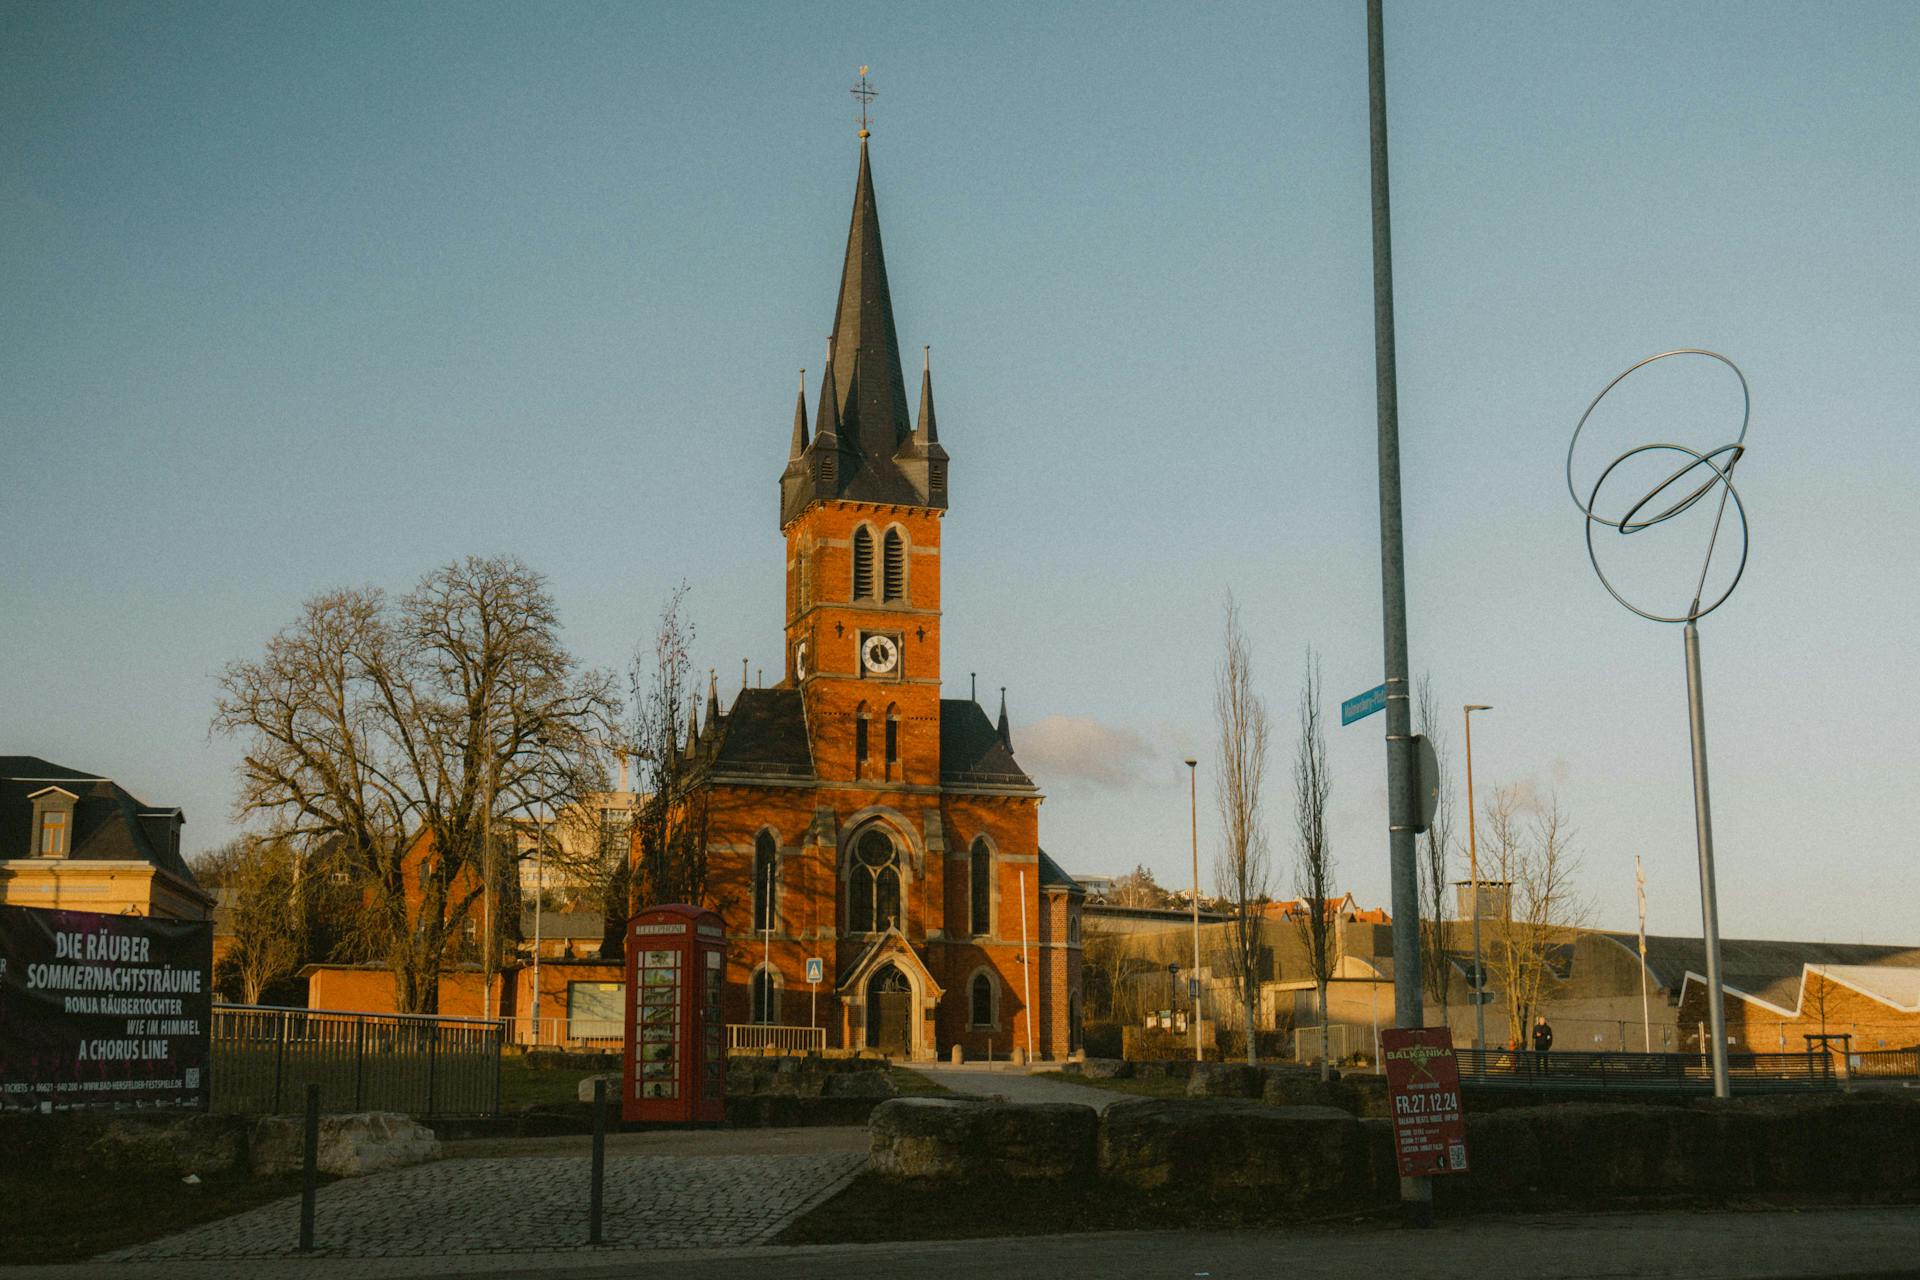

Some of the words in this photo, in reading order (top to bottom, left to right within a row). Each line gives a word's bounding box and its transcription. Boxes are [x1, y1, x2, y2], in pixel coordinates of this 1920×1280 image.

[55, 932, 82, 959] DIE
[86, 929, 150, 962] RÄUBER
[27, 964, 201, 993] SOMMERNACHTSTRÄUME
[65, 997, 99, 1013] RONJA
[100, 994, 182, 1015] RÄUBERTOCHTER
[127, 1020, 145, 1035] WIE
[147, 1020, 159, 1035] IM
[160, 1020, 200, 1035] HIMMEL
[79, 1040, 87, 1060] A
[89, 1040, 140, 1060] CHORUS
[142, 1040, 168, 1059] LINE
[1387, 1048, 1452, 1060] BALKANIKA
[4, 1083, 28, 1093] TICKETS
[1396, 1092, 1458, 1114] FR.27.12.24
